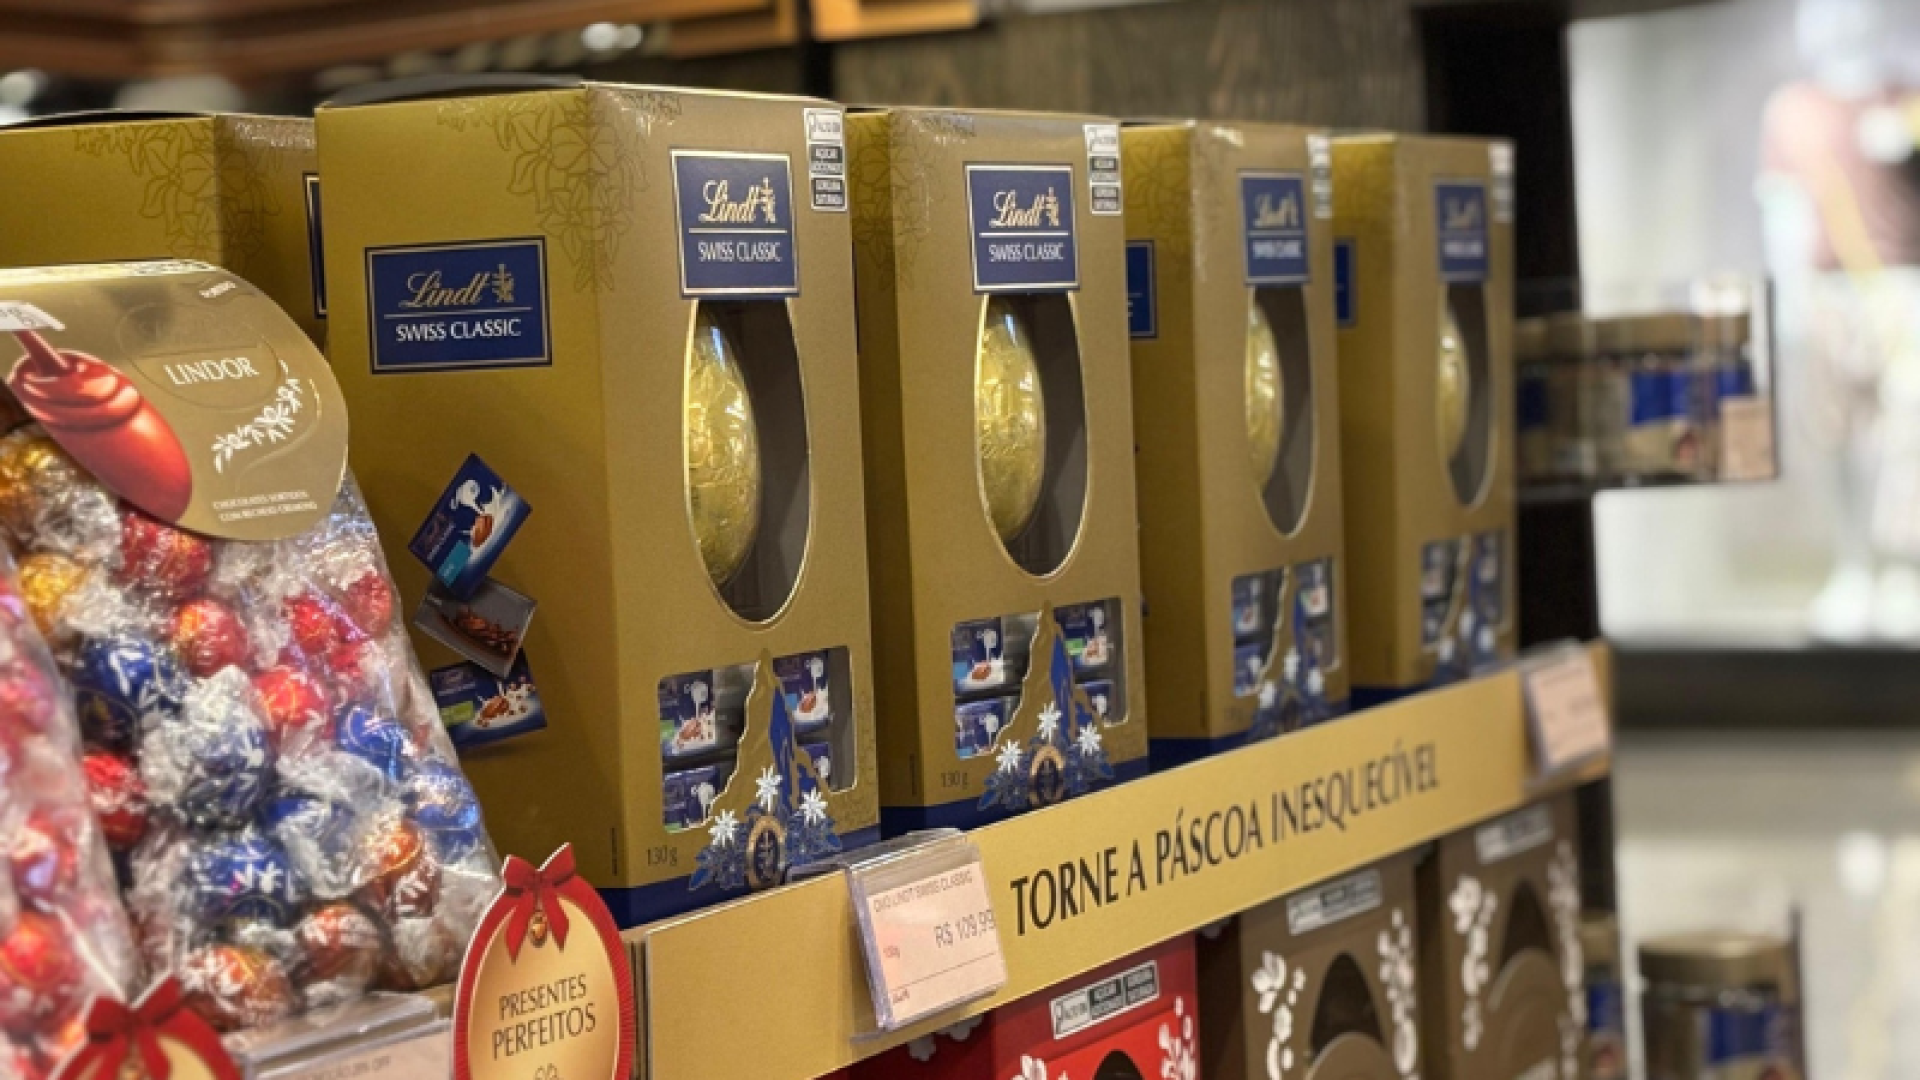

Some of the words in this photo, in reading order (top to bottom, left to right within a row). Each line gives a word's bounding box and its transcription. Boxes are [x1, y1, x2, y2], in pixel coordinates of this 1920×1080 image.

[698, 180, 760, 223] Lindt
[989, 190, 1046, 228] Lindt
[698, 241, 733, 262] SWISS
[736, 241, 782, 262] CLASSIC
[988, 243, 1021, 262] SWISS
[1023, 242, 1064, 262] CLASSIC
[398, 270, 490, 308] Lindt
[395, 322, 447, 342] SWISS
[450, 318, 522, 339] CLASSIC
[163, 357, 259, 385] LINDOR
[1010, 846, 1118, 936] TORNE
[1126, 839, 1147, 896] A
[1155, 807, 1263, 885] PÁSCOA
[1271, 741, 1440, 844] INESQUECÍVEL
[934, 921, 954, 948] R$
[955, 909, 996, 940] 109,99
[498, 972, 587, 1020] PRESENTES
[491, 1003, 596, 1061] PERFEITOS
